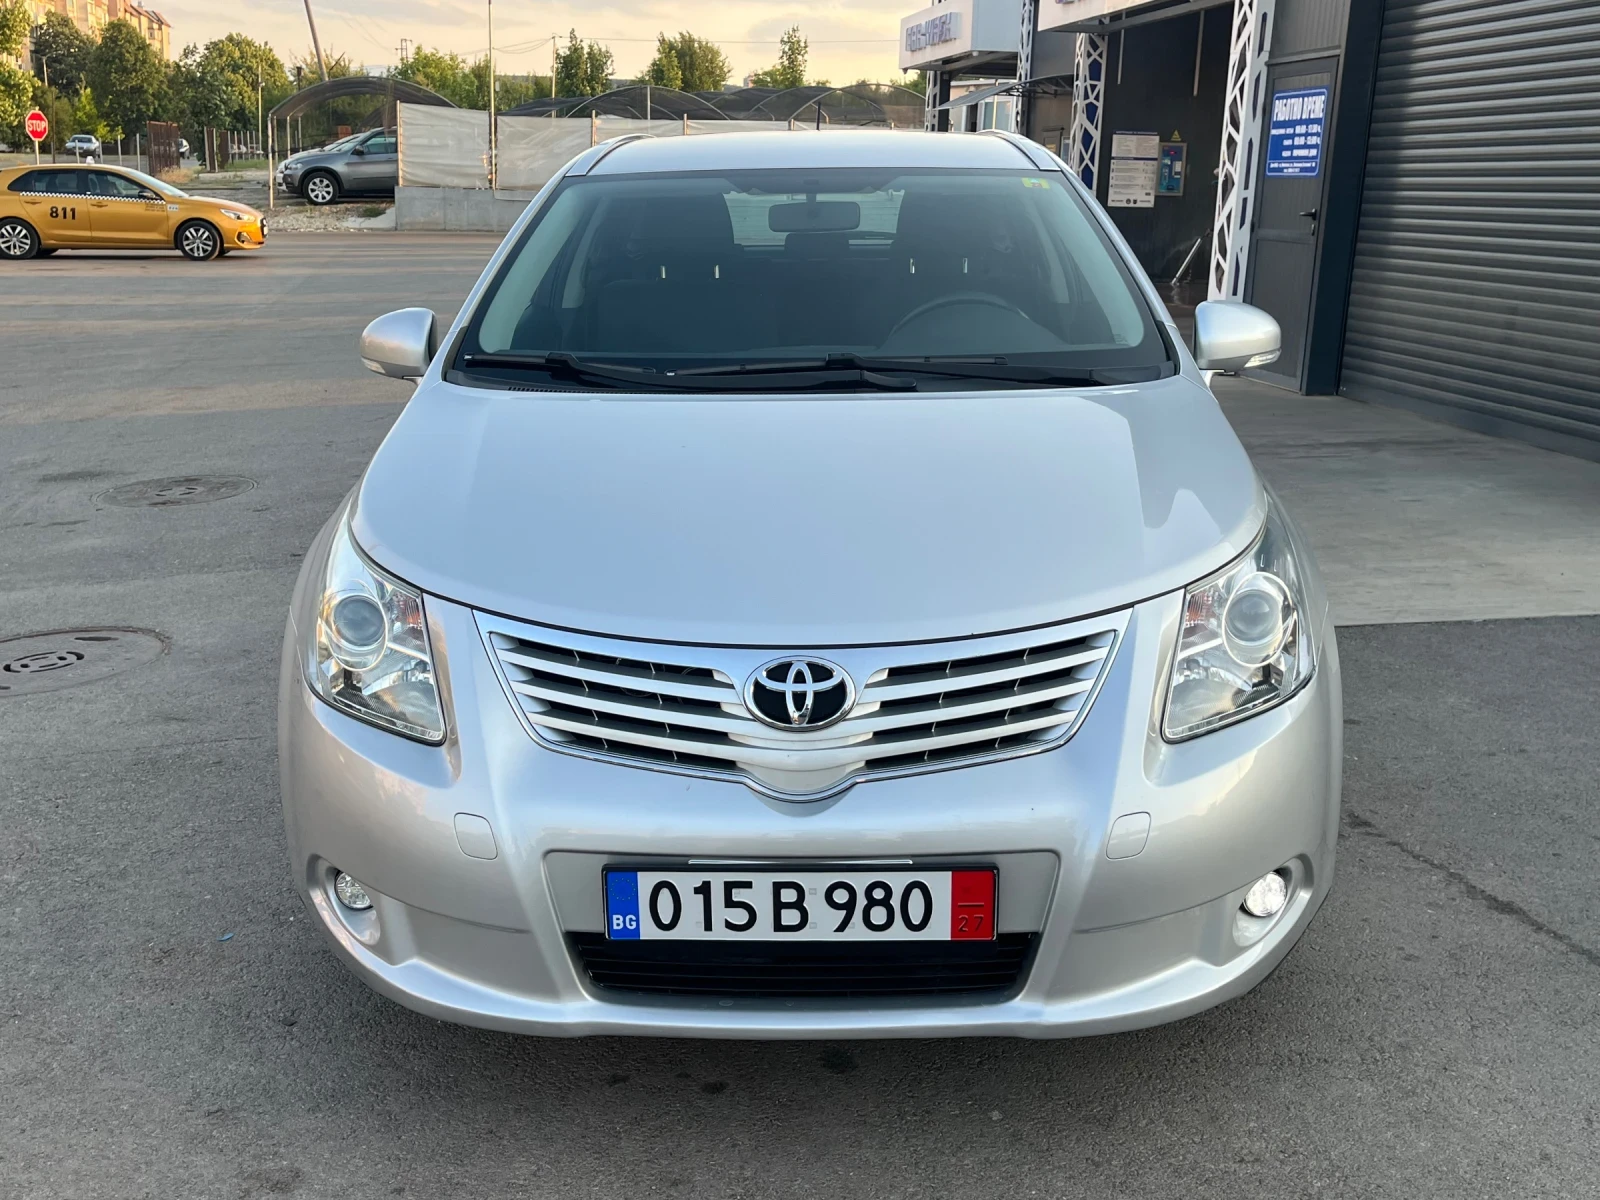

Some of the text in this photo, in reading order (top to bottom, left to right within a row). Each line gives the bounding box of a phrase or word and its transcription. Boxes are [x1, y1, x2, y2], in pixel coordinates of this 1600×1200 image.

[28, 120, 46, 132] STOP
[49, 206, 76, 220] 811
[612, 914, 637, 930] BG
[957, 914, 984, 932] 27
